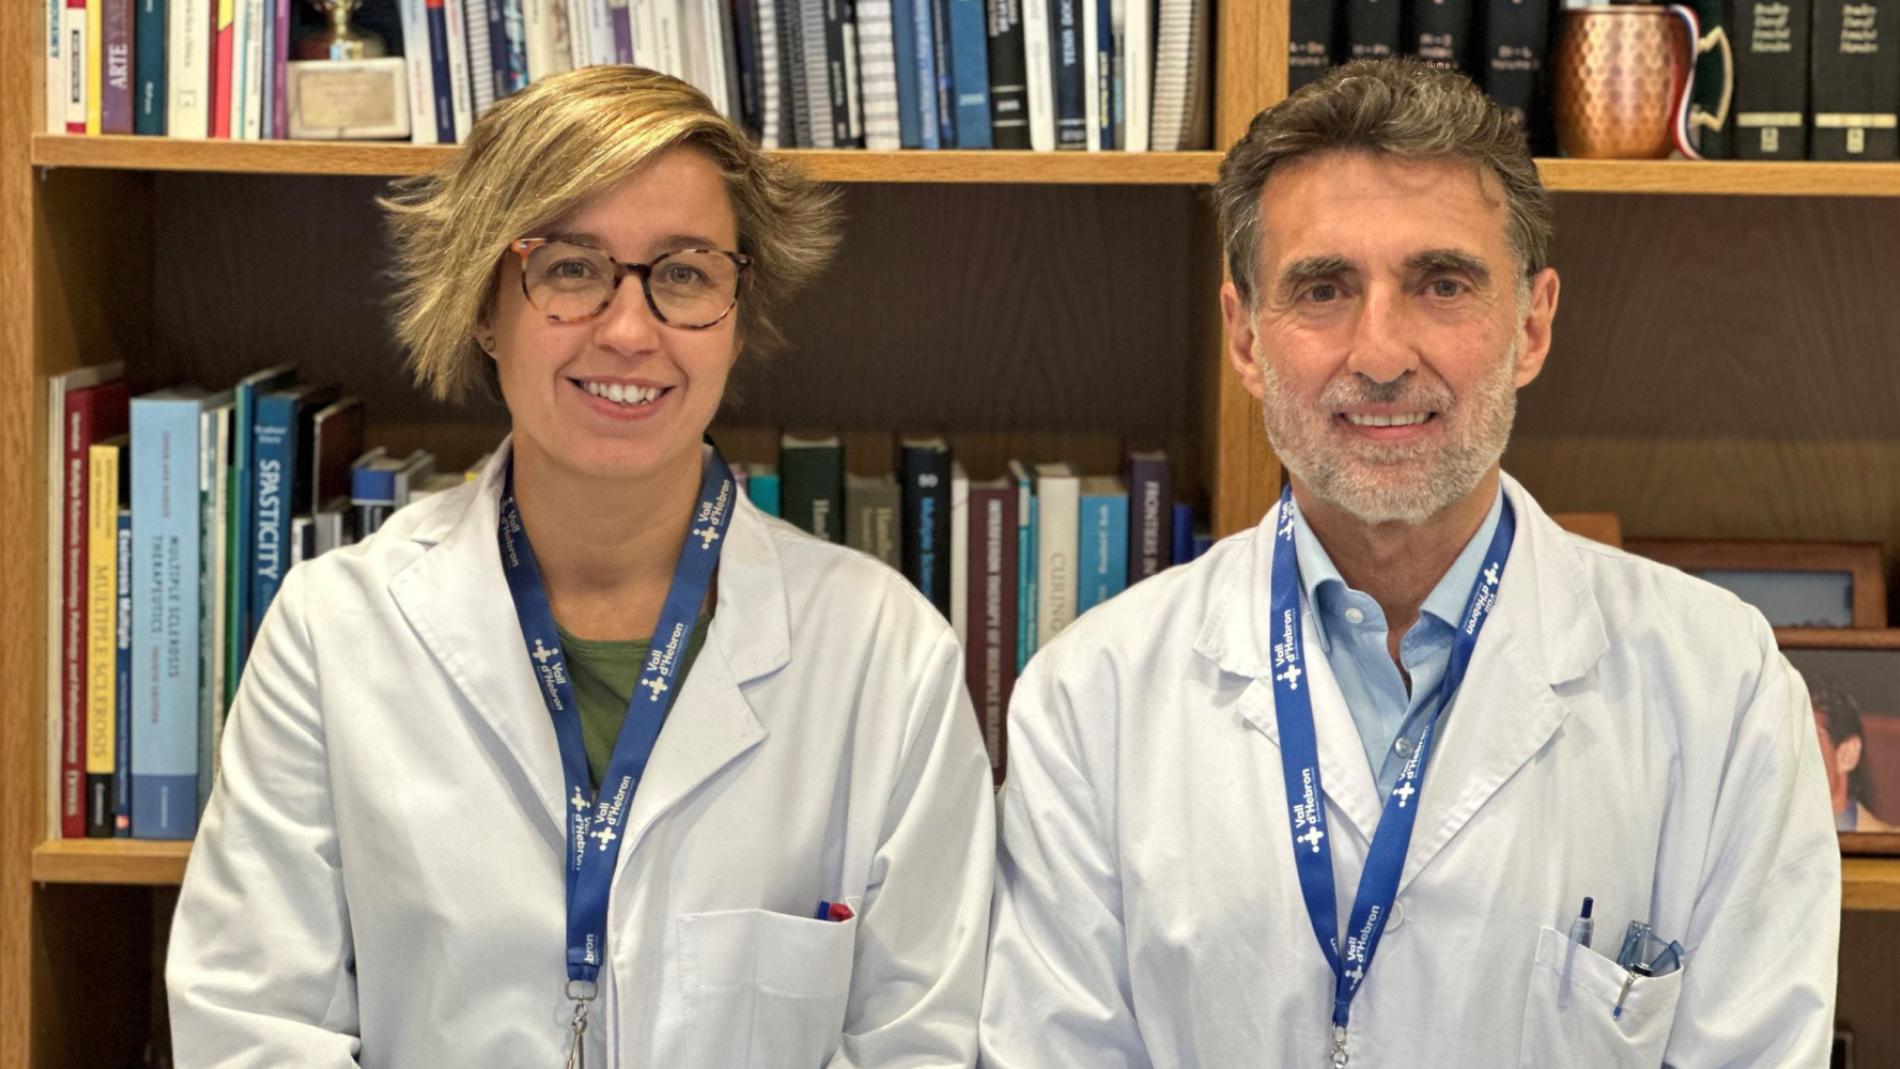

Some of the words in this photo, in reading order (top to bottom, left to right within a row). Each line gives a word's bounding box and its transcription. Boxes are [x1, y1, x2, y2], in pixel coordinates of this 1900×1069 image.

[108, 43, 128, 90] ARTE
[258, 459, 281, 580] SPASTICITY
[698, 501, 713, 523] Vall
[711, 479, 730, 526] d'Hebron
[1145, 481, 1160, 555] FRONTIERS
[151, 535, 163, 635] THERAPEUTICS
[169, 535, 180, 602] MULTIPLE
[1050, 553, 1066, 631] CURING
[94, 564, 109, 658] MULTIPLE
[1284, 609, 1295, 663] d'Hebron
[1466, 585, 1490, 635] d'Hebron
[168, 605, 180, 679] SCLEROSIS
[647, 649, 663, 673] Vall
[659, 622, 684, 676] d'Hebron
[1274, 643, 1285, 668] Vall
[541, 665, 563, 711] d'Hebron
[552, 662, 566, 685] Vall
[93, 661, 107, 757] SCLEROSIS
[594, 802, 611, 824] Vall
[606, 775, 631, 826] d'Hebron
[1294, 804, 1306, 829] Vall
[1302, 767, 1316, 824] d'Hebron
[1347, 936, 1358, 962] Vall
[1356, 904, 1380, 963] d'Hebron
